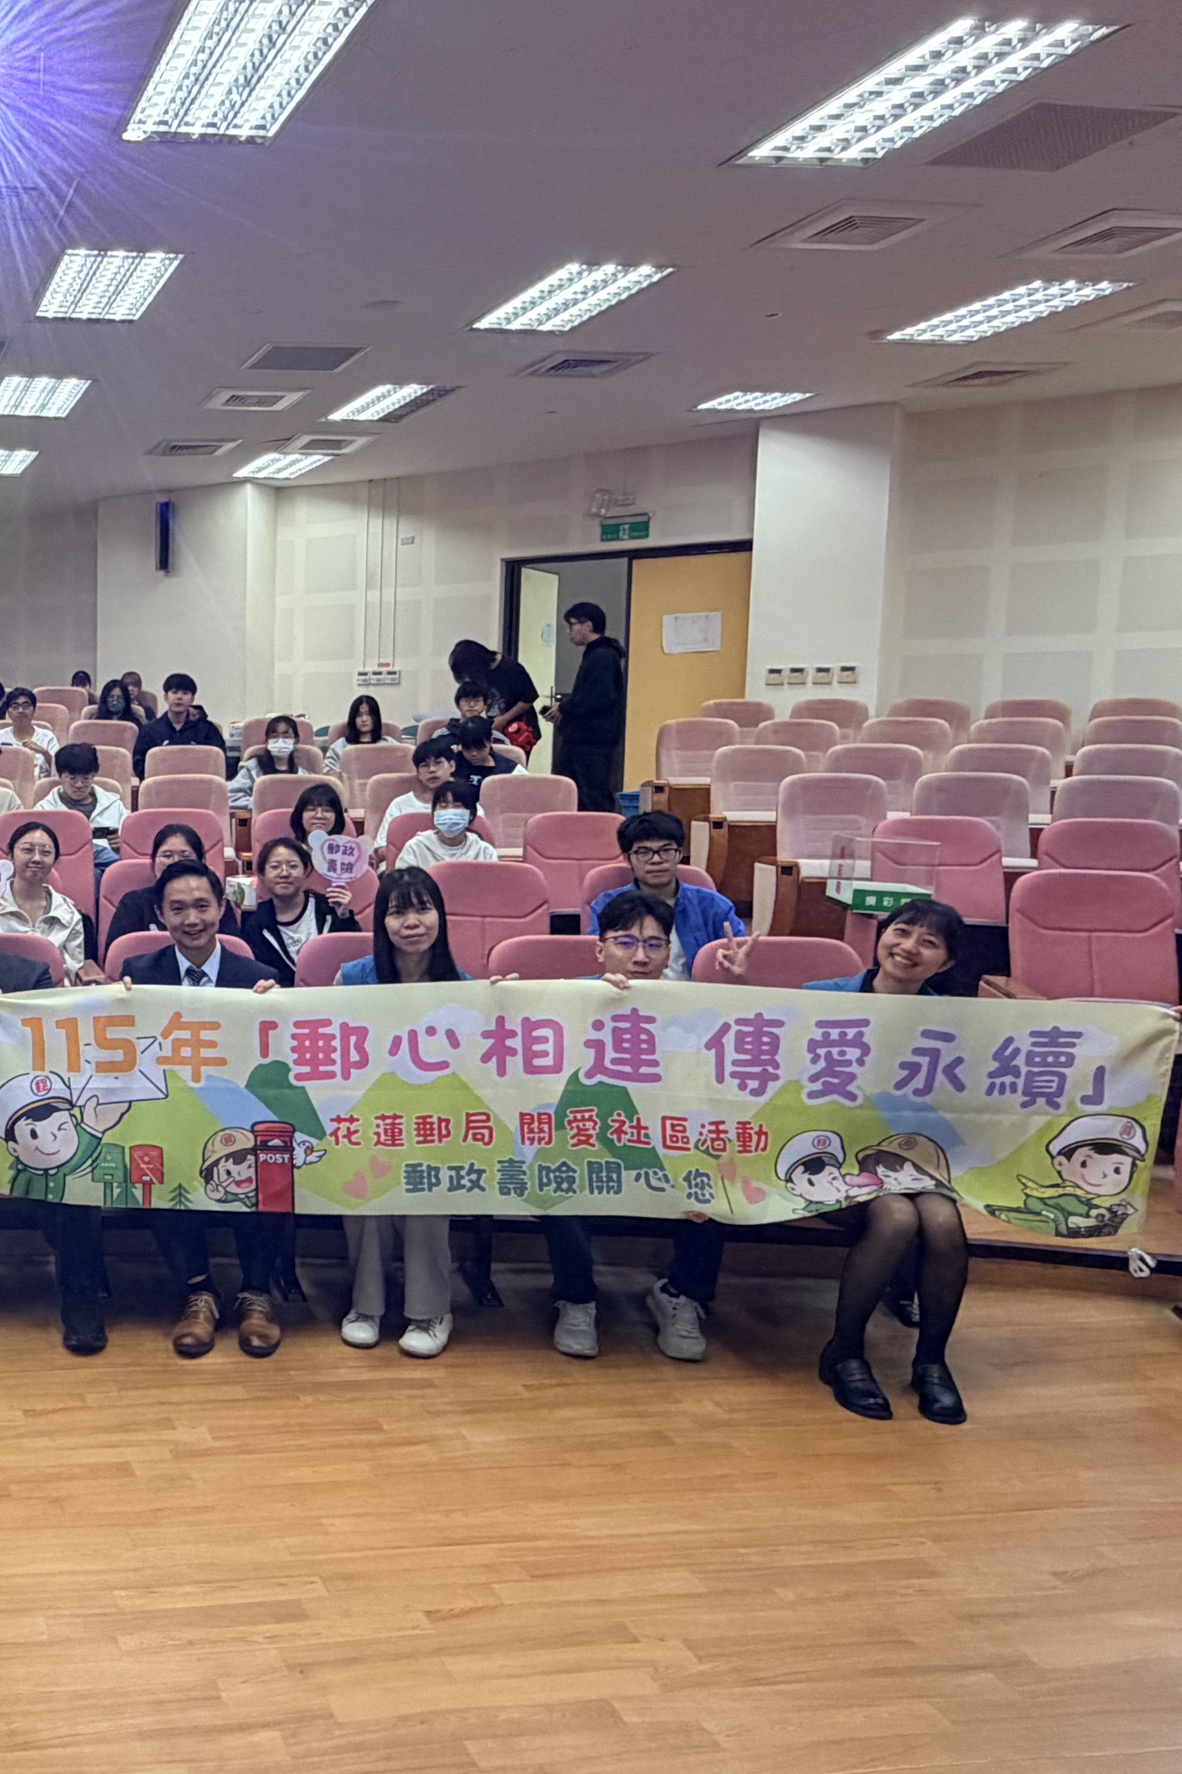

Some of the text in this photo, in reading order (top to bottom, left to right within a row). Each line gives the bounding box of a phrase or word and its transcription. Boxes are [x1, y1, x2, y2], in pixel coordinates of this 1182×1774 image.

[259, 1153, 291, 1164] POST
[402, 1157, 716, 1205] 郵政壽險關心您
